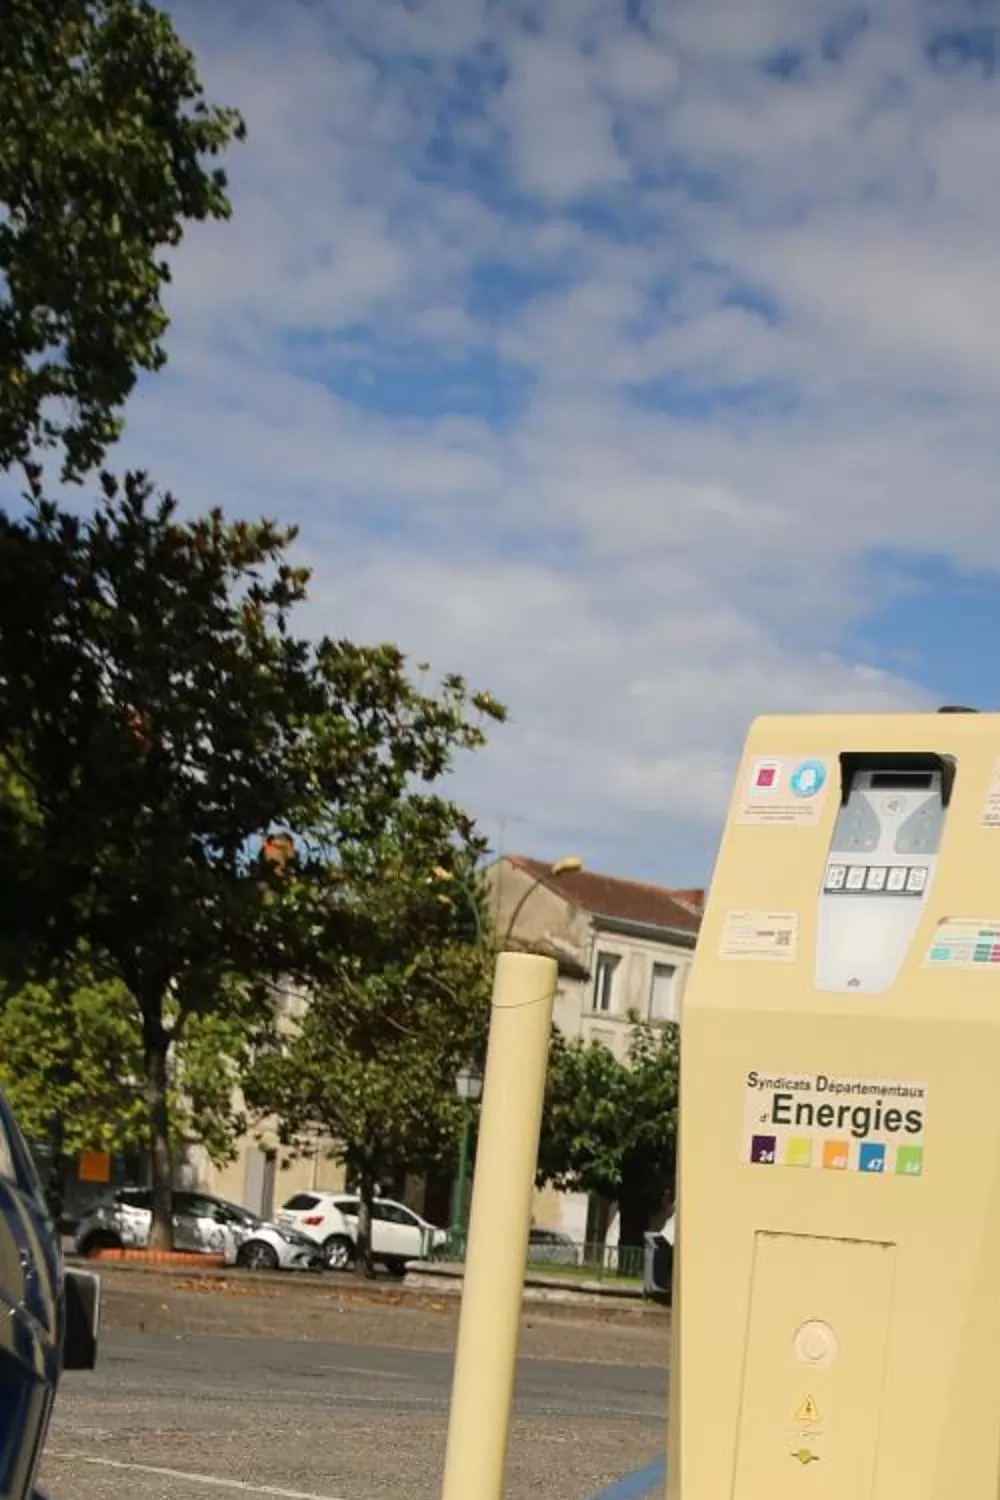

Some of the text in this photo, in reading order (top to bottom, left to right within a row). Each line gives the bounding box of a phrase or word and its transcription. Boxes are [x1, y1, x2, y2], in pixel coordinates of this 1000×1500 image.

[747, 1071, 812, 1091] Syndicats
[771, 1093, 923, 1138] Energies
[759, 1149, 774, 1163] 24
[867, 1158, 883, 1170] 47
